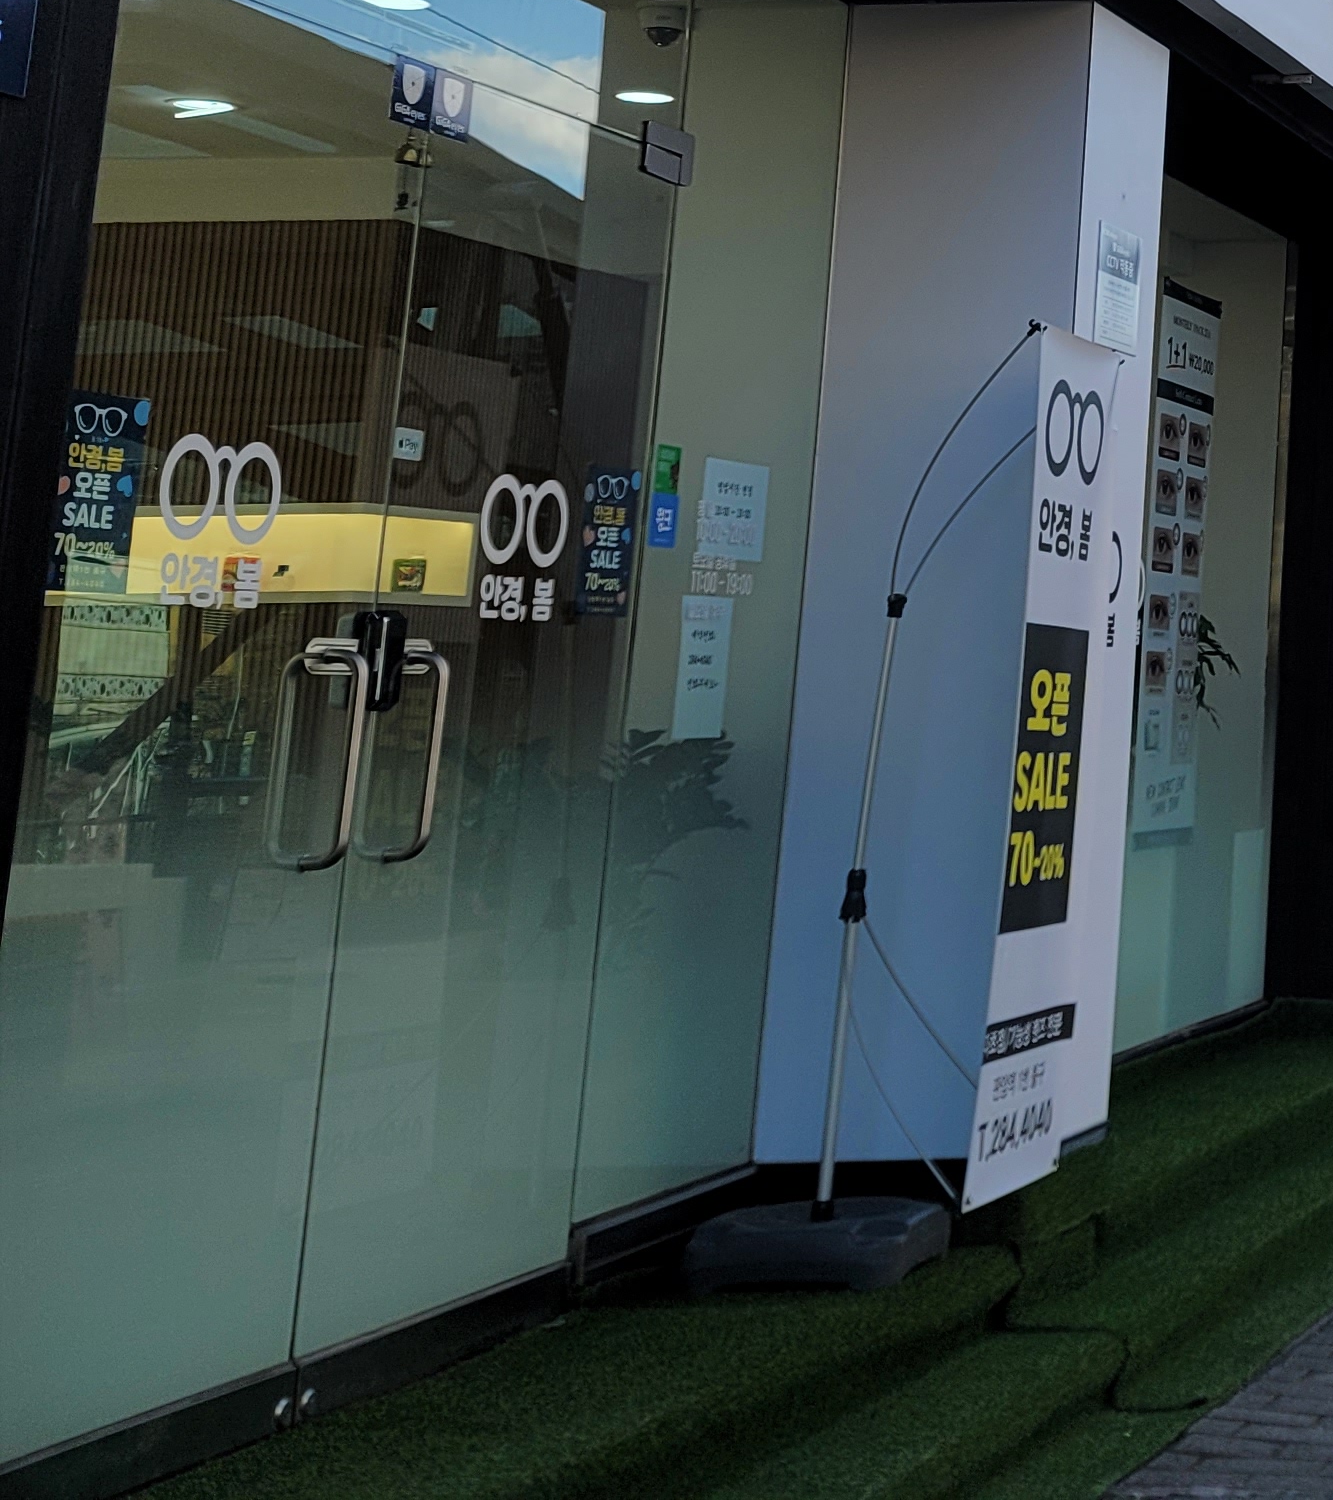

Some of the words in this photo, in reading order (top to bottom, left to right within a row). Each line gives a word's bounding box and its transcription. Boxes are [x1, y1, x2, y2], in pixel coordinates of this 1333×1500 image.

[72, 472, 112, 501] 오픈
[62, 501, 114, 530] SALE
[596, 526, 620, 548] 오픈
[1078, 507, 1093, 562] 봄
[589, 548, 622, 570] SALE
[531, 577, 556, 623] 봄
[1026, 668, 1073, 737] 오픈
[1013, 750, 1072, 814] SALE
